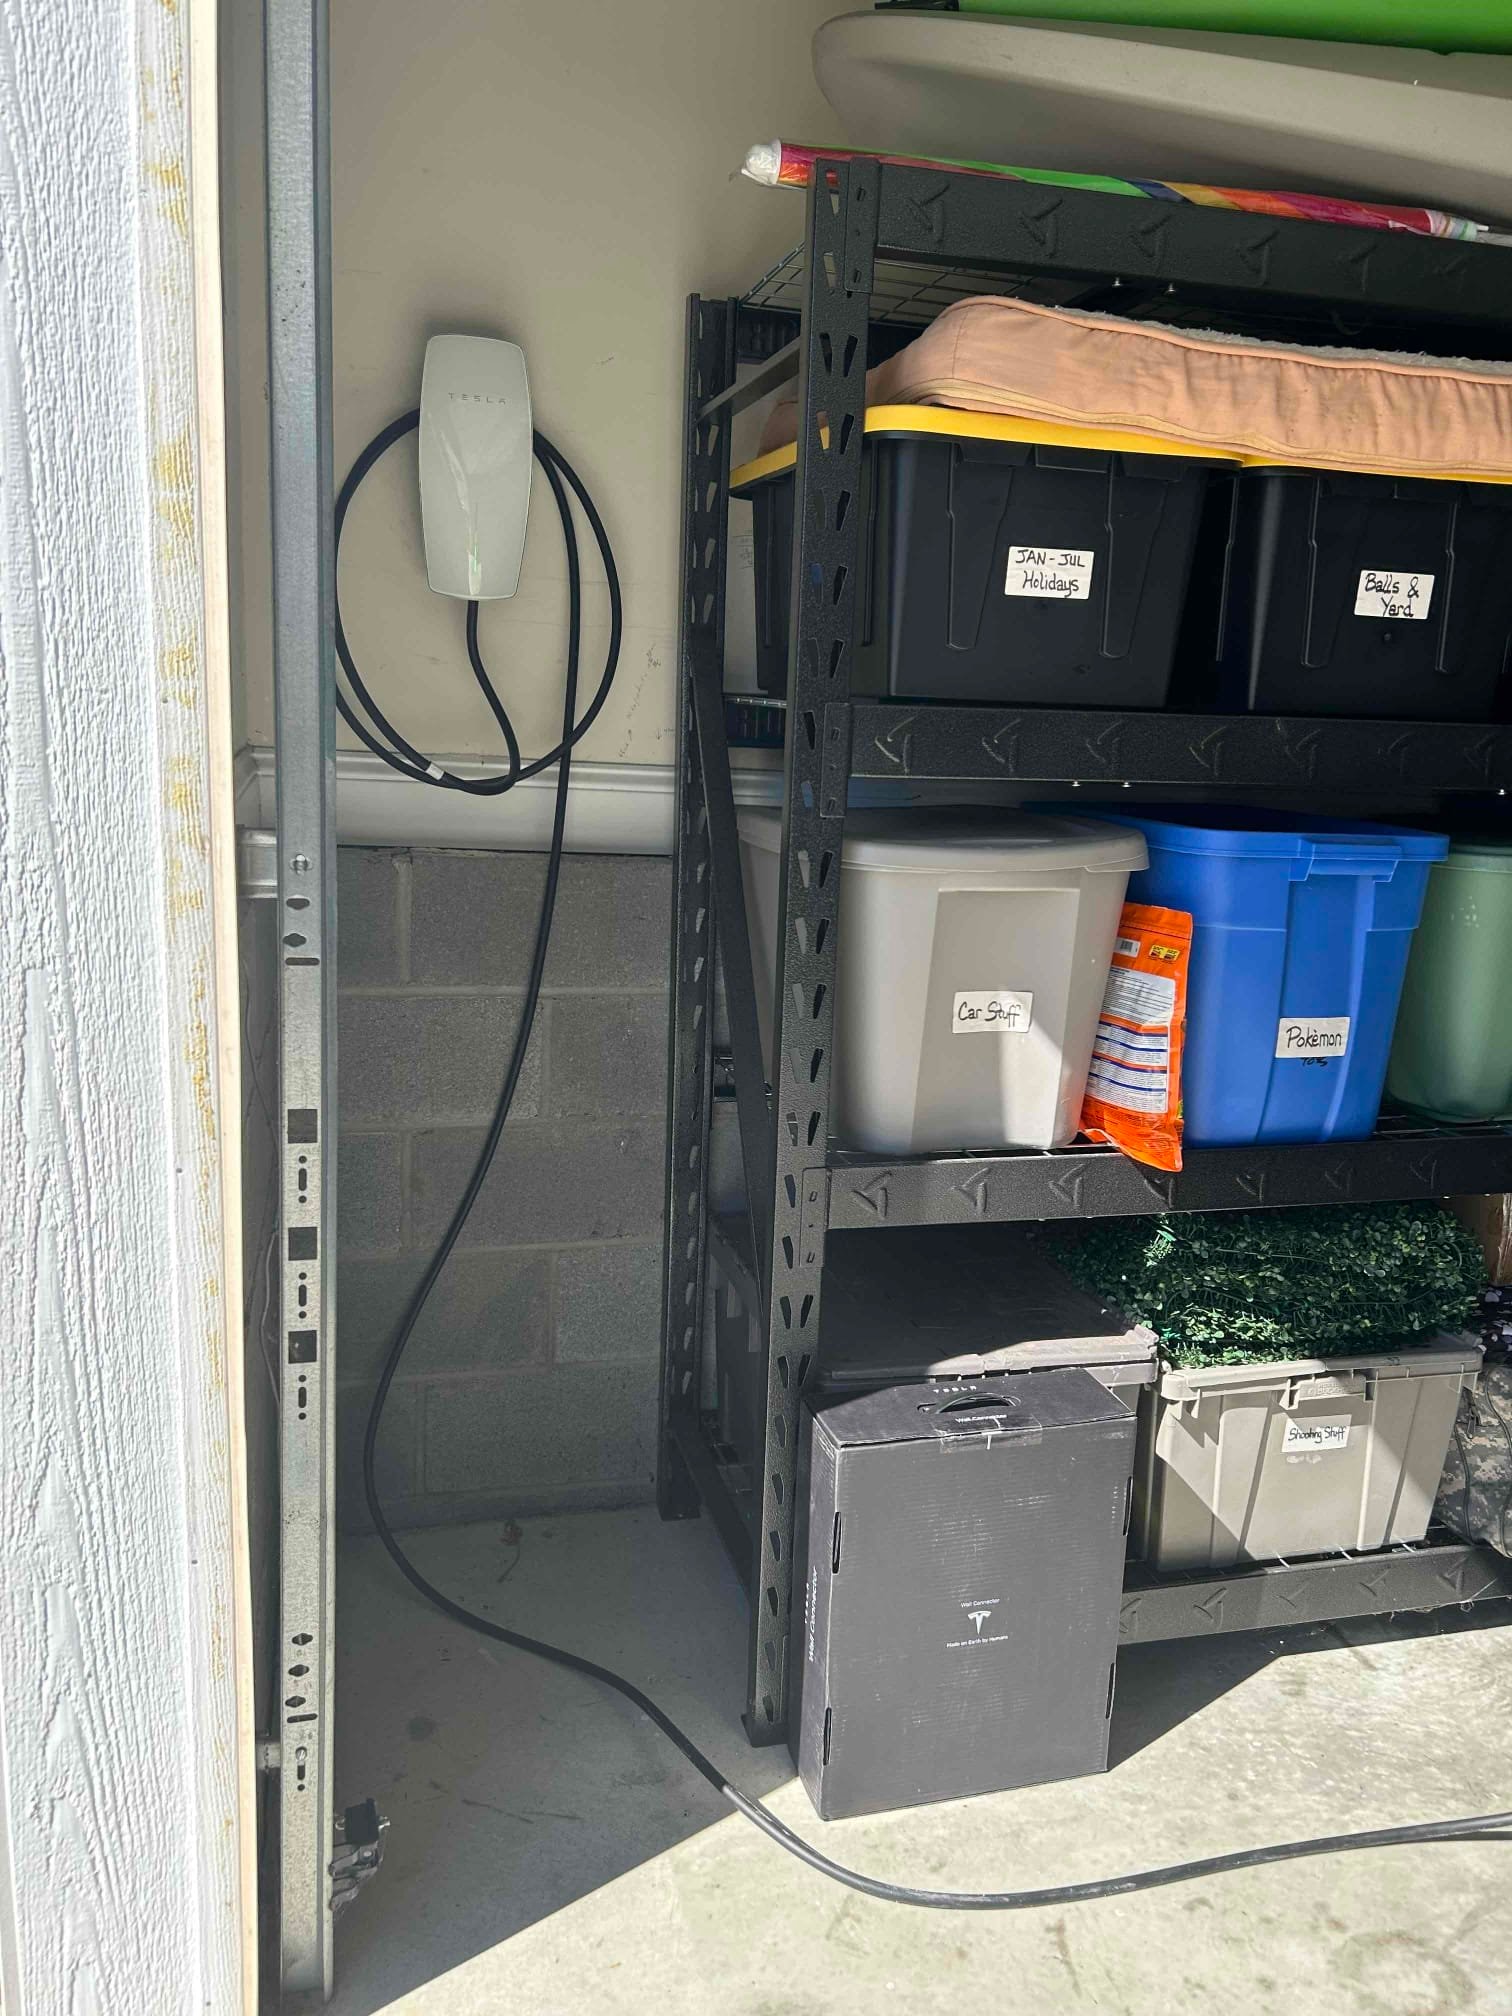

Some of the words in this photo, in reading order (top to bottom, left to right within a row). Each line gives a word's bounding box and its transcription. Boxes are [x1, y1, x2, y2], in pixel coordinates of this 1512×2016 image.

[1022, 570, 1080, 598] Holidays
[1365, 572, 1400, 594] Balls
[1407, 576, 1419, 598] &
[1381, 595, 1414, 617] Yard
[958, 1001, 982, 1021] Car
[984, 1001, 1021, 1028] Stuff
[1288, 1427, 1322, 1444] Shooting
[1324, 1425, 1347, 1441] Stuff
